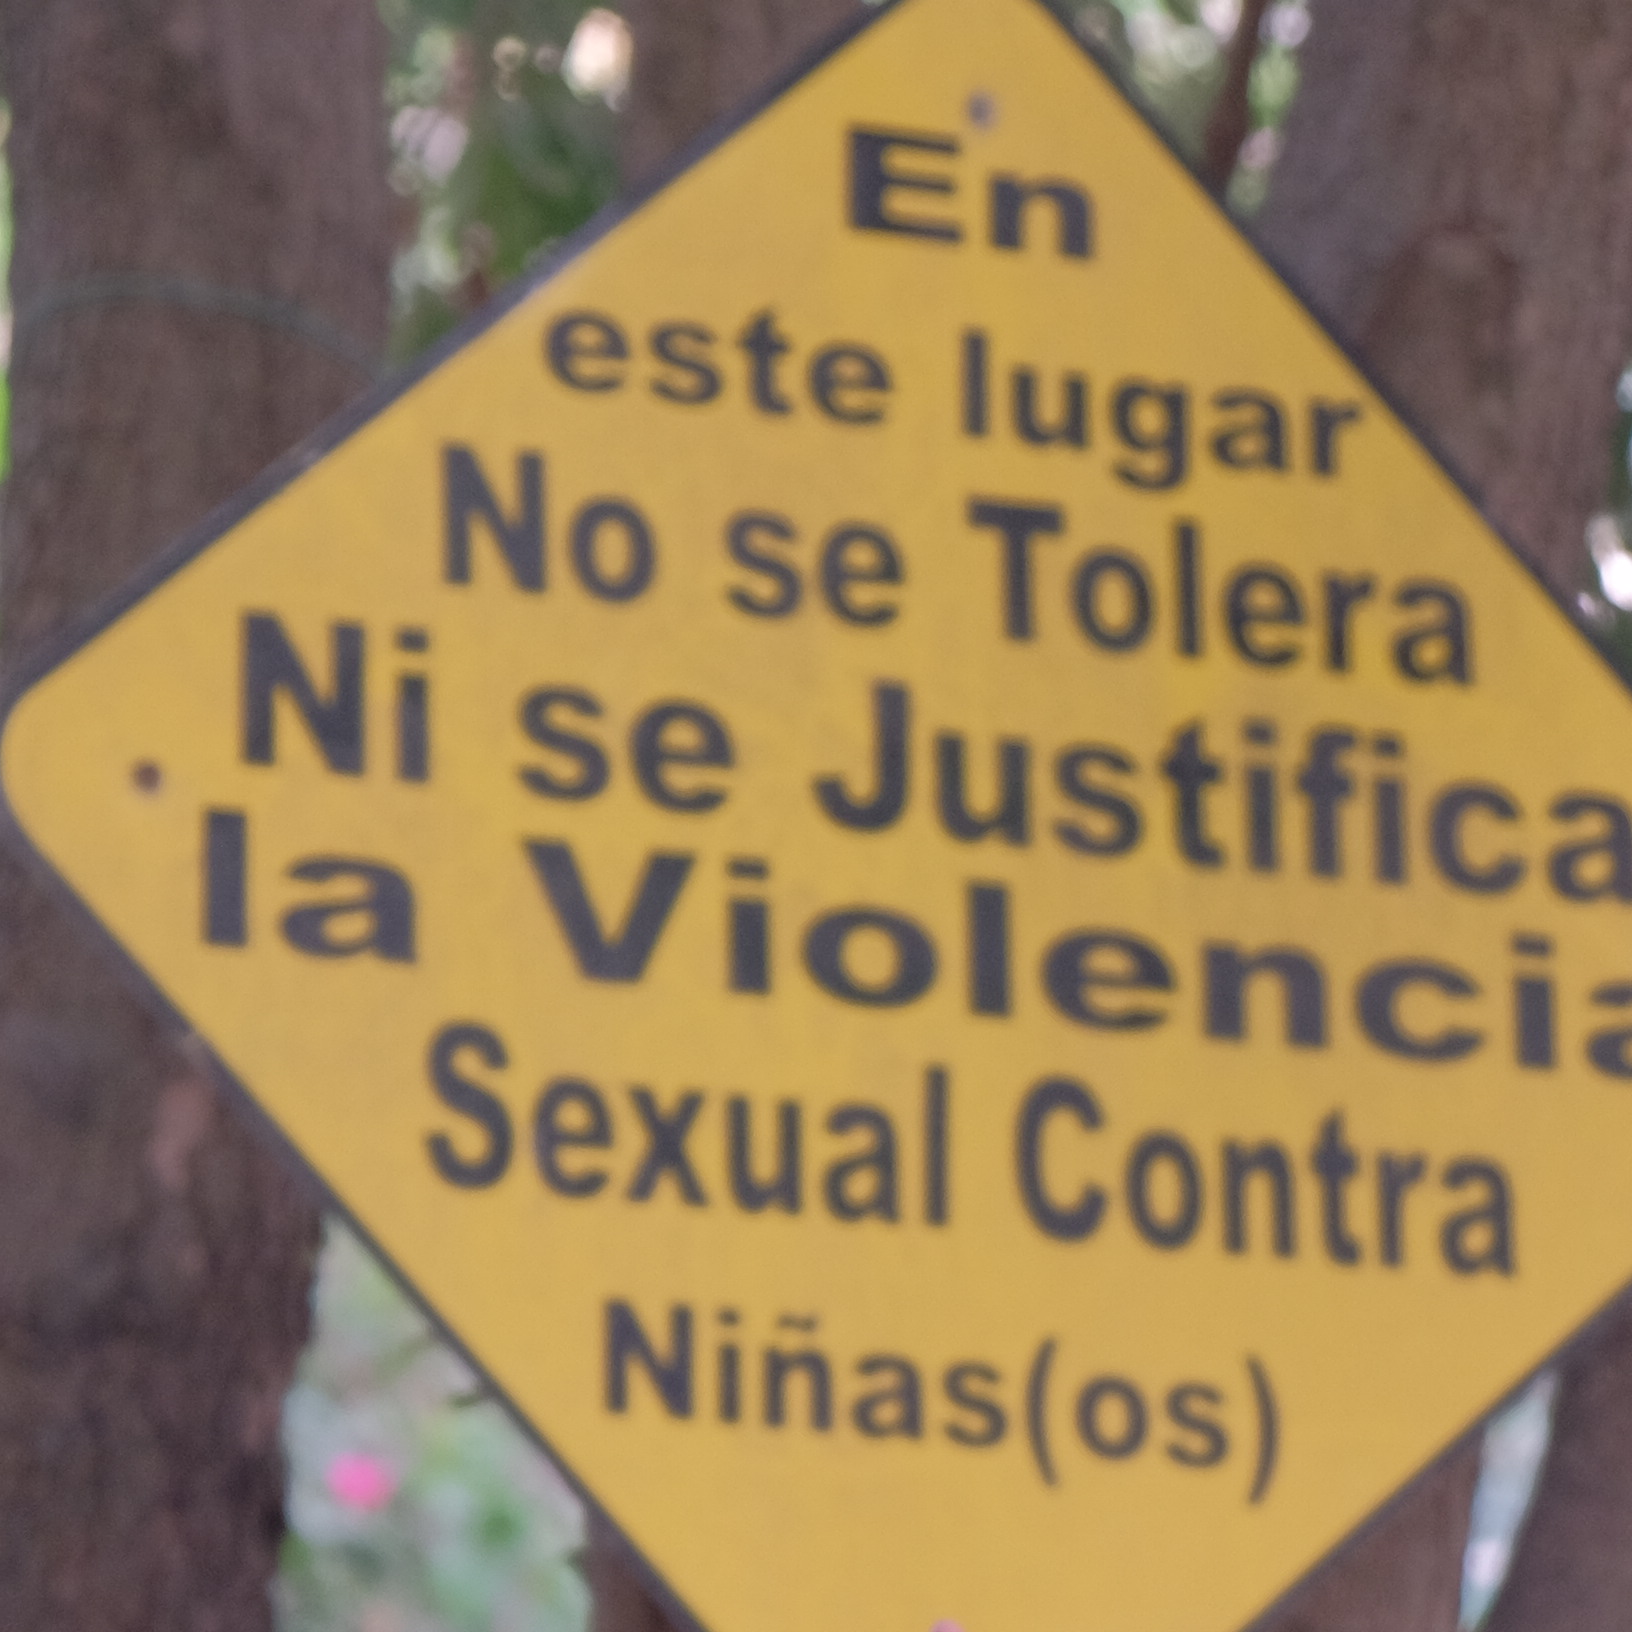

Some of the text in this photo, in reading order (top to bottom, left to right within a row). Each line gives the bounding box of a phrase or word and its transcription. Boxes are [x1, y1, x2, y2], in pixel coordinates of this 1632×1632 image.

[844, 122, 1097, 263] En
[542, 308, 1364, 495] este lugar
[440, 441, 1477, 690] No se Tolera
[238, 608, 434, 787] Ni
[517, 684, 738, 817] se
[200, 807, 420, 967] la
[424, 1020, 1518, 1280] Sexual Contra
[602, 1298, 1282, 1508] Niñas(os)
